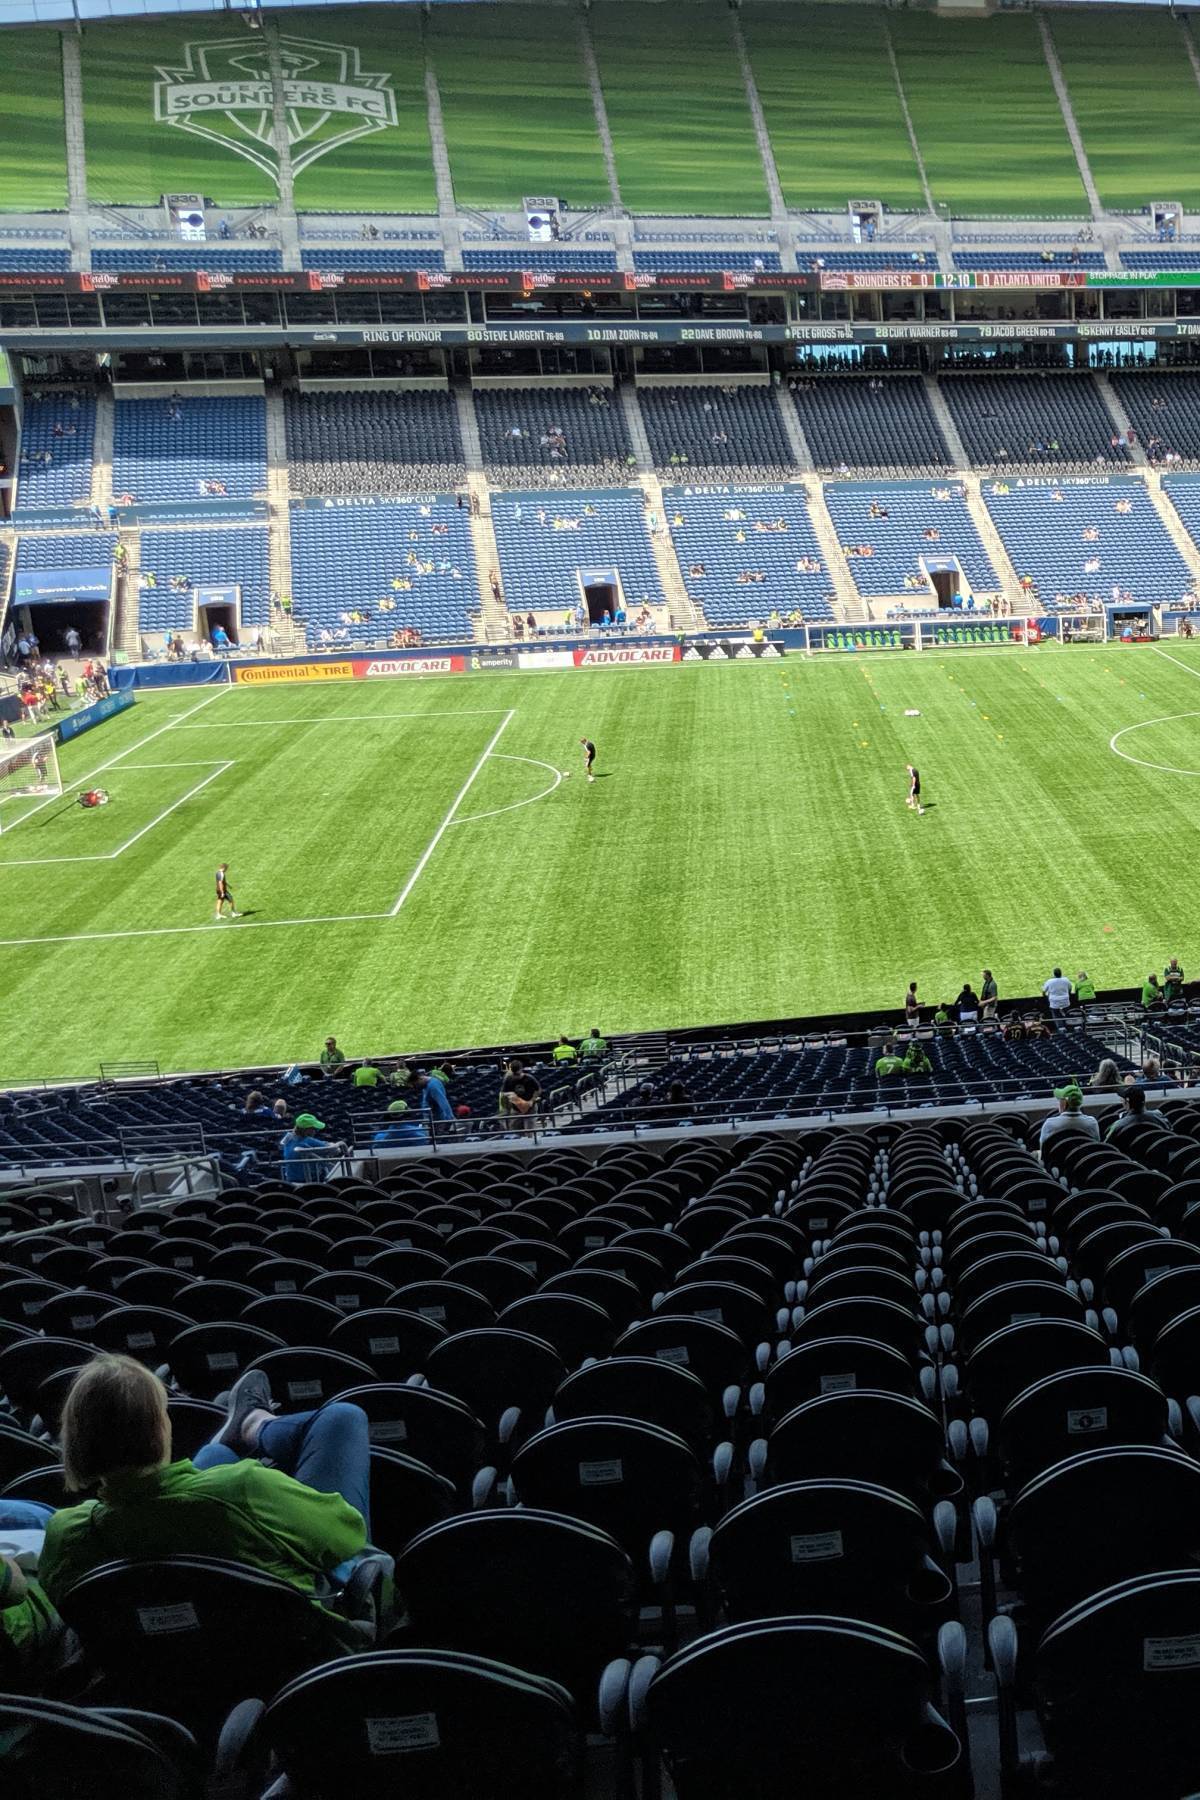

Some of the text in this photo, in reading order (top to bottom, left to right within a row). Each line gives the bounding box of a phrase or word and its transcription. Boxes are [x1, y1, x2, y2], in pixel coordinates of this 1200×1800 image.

[347, 96, 383, 113] FC
[171, 195, 198, 203] 330
[528, 198, 554, 206] 332
[853, 201, 876, 209] 334
[854, 274, 912, 288] SOUNDERS FC
[921, 274, 928, 287] 0
[942, 274, 970, 287] 12:10
[993, 274, 1061, 287] ATLANTA UNITED
[467, 330, 482, 341] 80
[483, 330, 508, 341] STEVE
[509, 330, 545, 341] LARGENT
[587, 329, 601, 340] 10
[602, 329, 617, 340] JIM
[617, 329, 640, 340] ZORN
[681, 329, 695, 339] 22
[695, 329, 713, 339] DAVE
[714, 329, 745, 339] BROWN
[792, 328, 810, 339] PETE
[811, 328, 836, 338] GROSS
[876, 327, 889, 337] 28
[890, 327, 905, 337] CURT
[906, 327, 940, 337] WARNER
[979, 327, 992, 337] 79
[993, 327, 1014, 337] JACOB
[1015, 327, 1039, 337] GREEN
[1077, 326, 1090, 336] 45
[1091, 326, 1113, 336] KENNY
[1115, 326, 1139, 336] EASLEY
[1177, 325, 1187, 335] 17
[363, 331, 442, 342] RING OF HONOR
[1026, 478, 1059, 486] DELTA
[336, 497, 376, 506] DELTA
[586, 650, 672, 663] ADVOCARE
[370, 660, 450, 674] ADVOCARE
[482, 658, 513, 667] amperity
[241, 665, 350, 683] Continental TIRE
